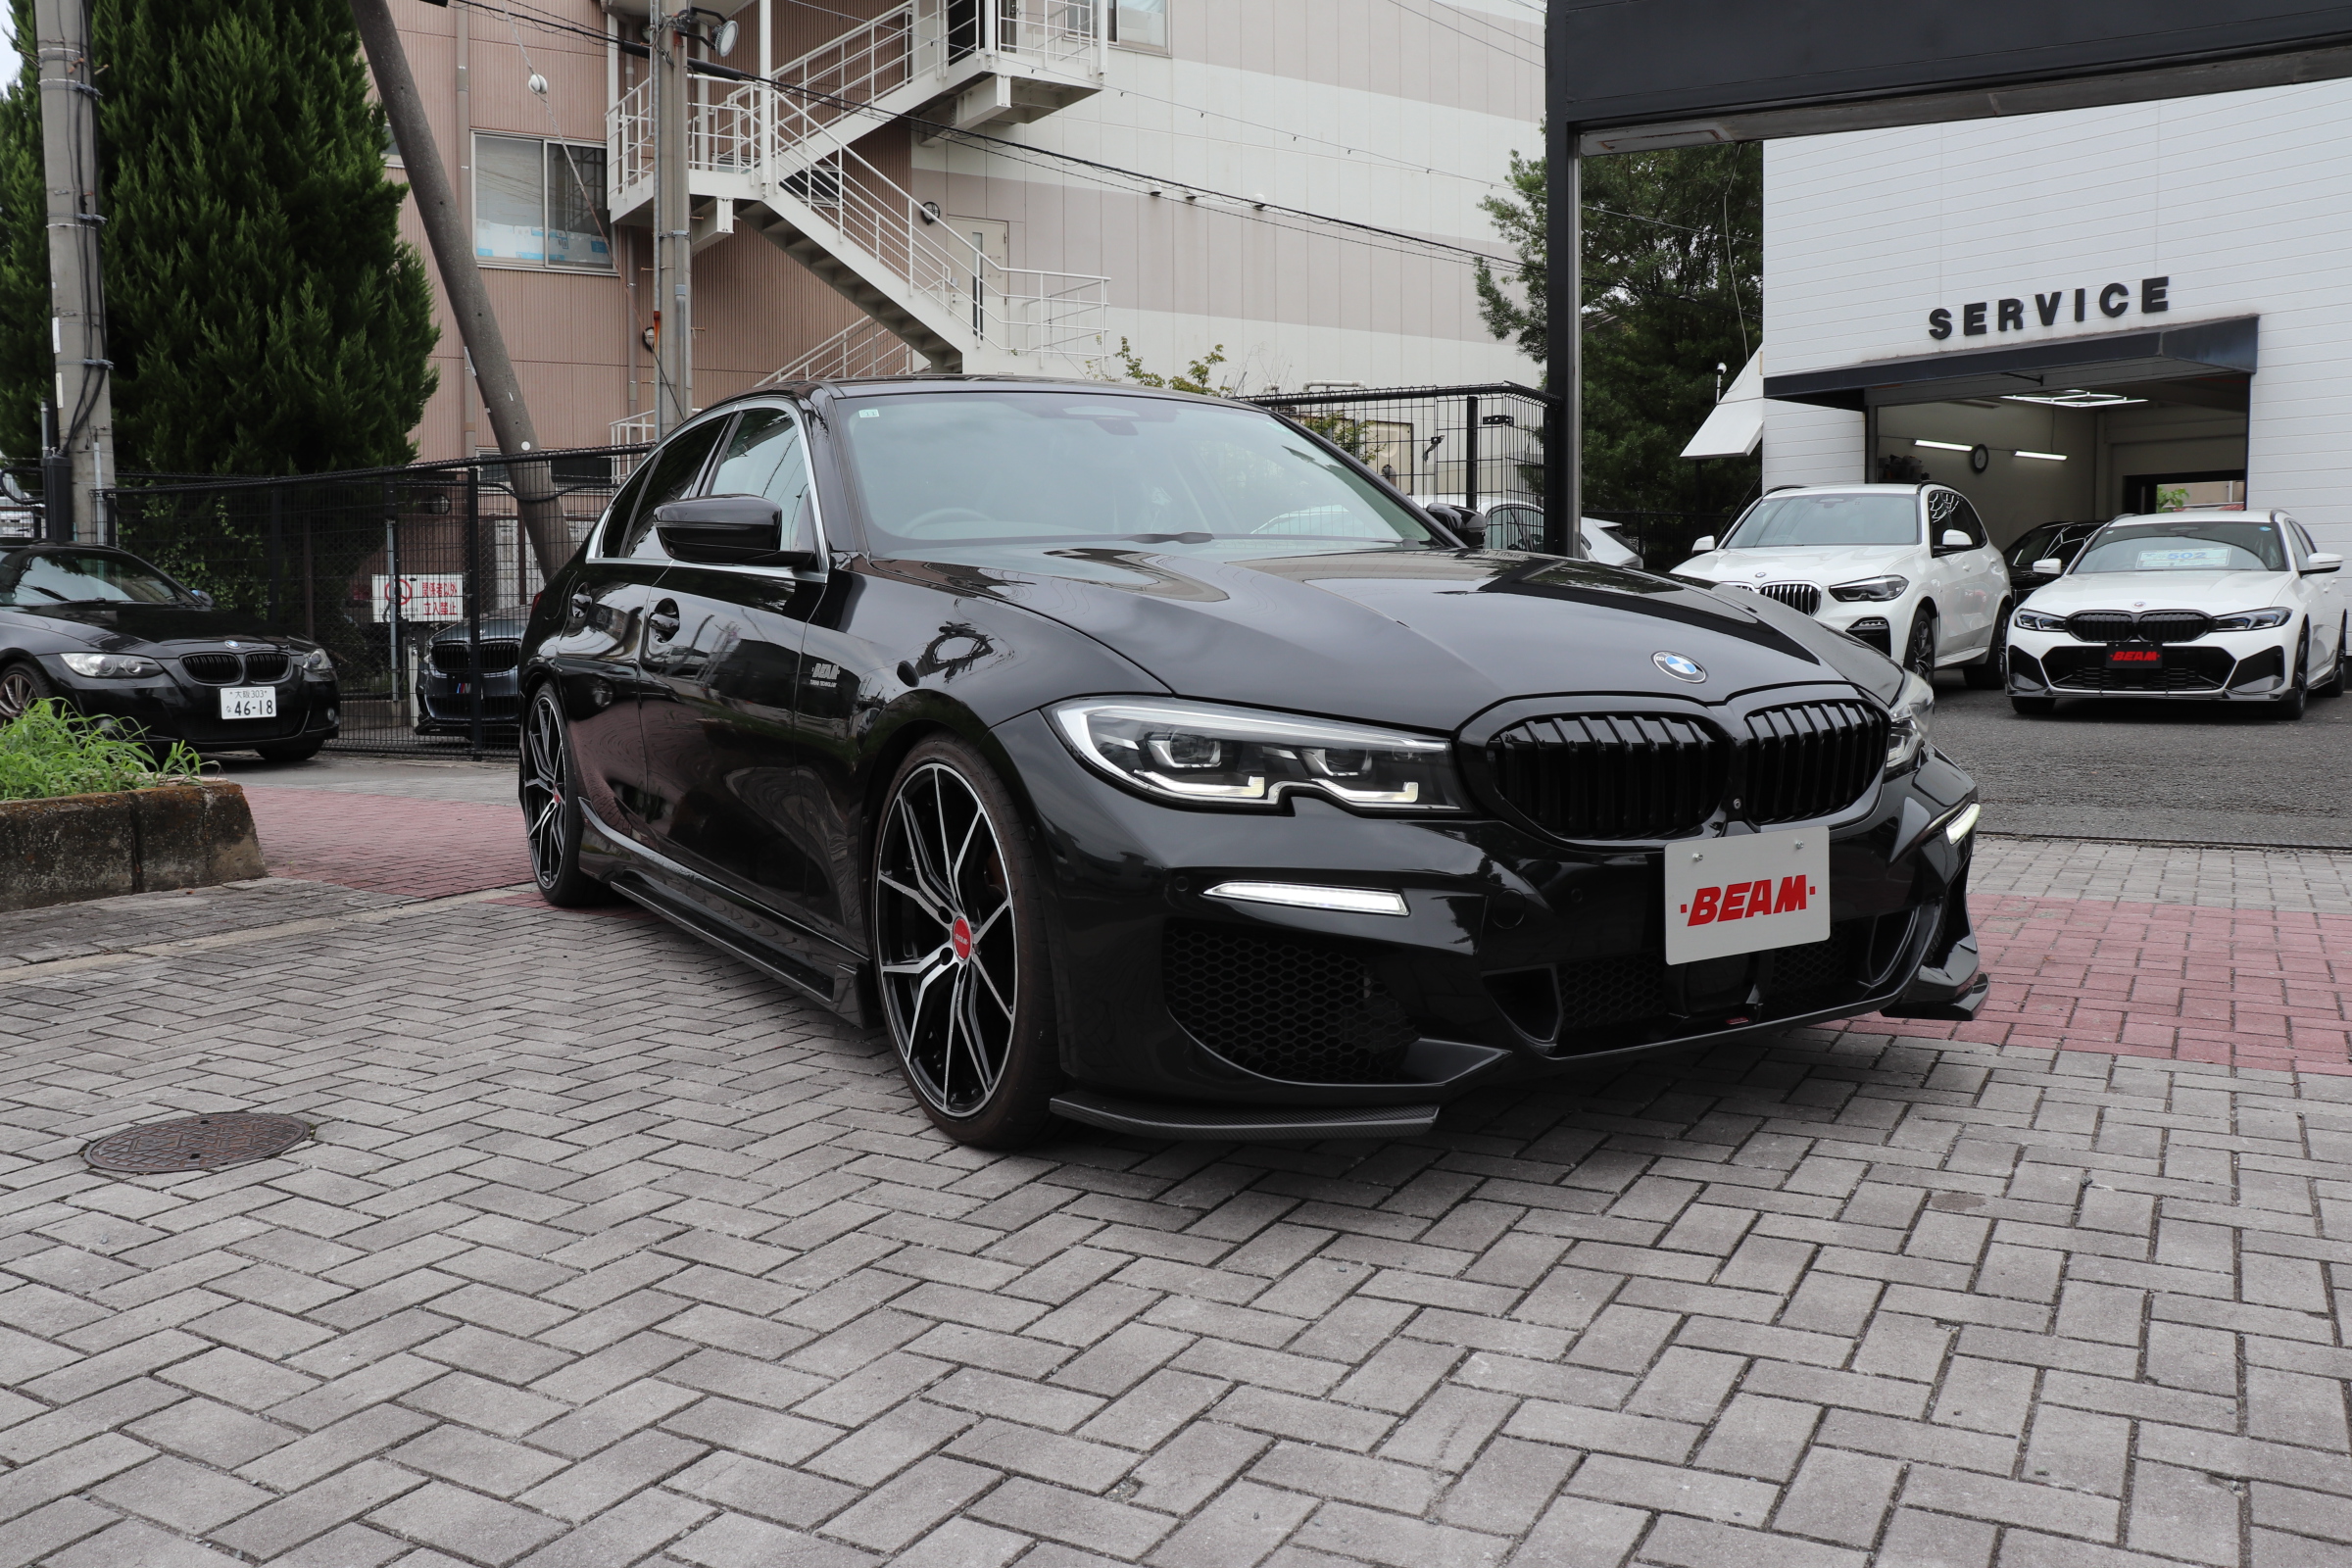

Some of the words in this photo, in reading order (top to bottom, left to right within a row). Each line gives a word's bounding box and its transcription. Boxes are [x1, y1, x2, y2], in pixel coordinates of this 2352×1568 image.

[1929, 276, 2169, 340] SERVICE
[421, 582, 458, 597] 関係者以外
[423, 602, 458, 615] 立入禁止
[234, 700, 273, 716] 46-18
